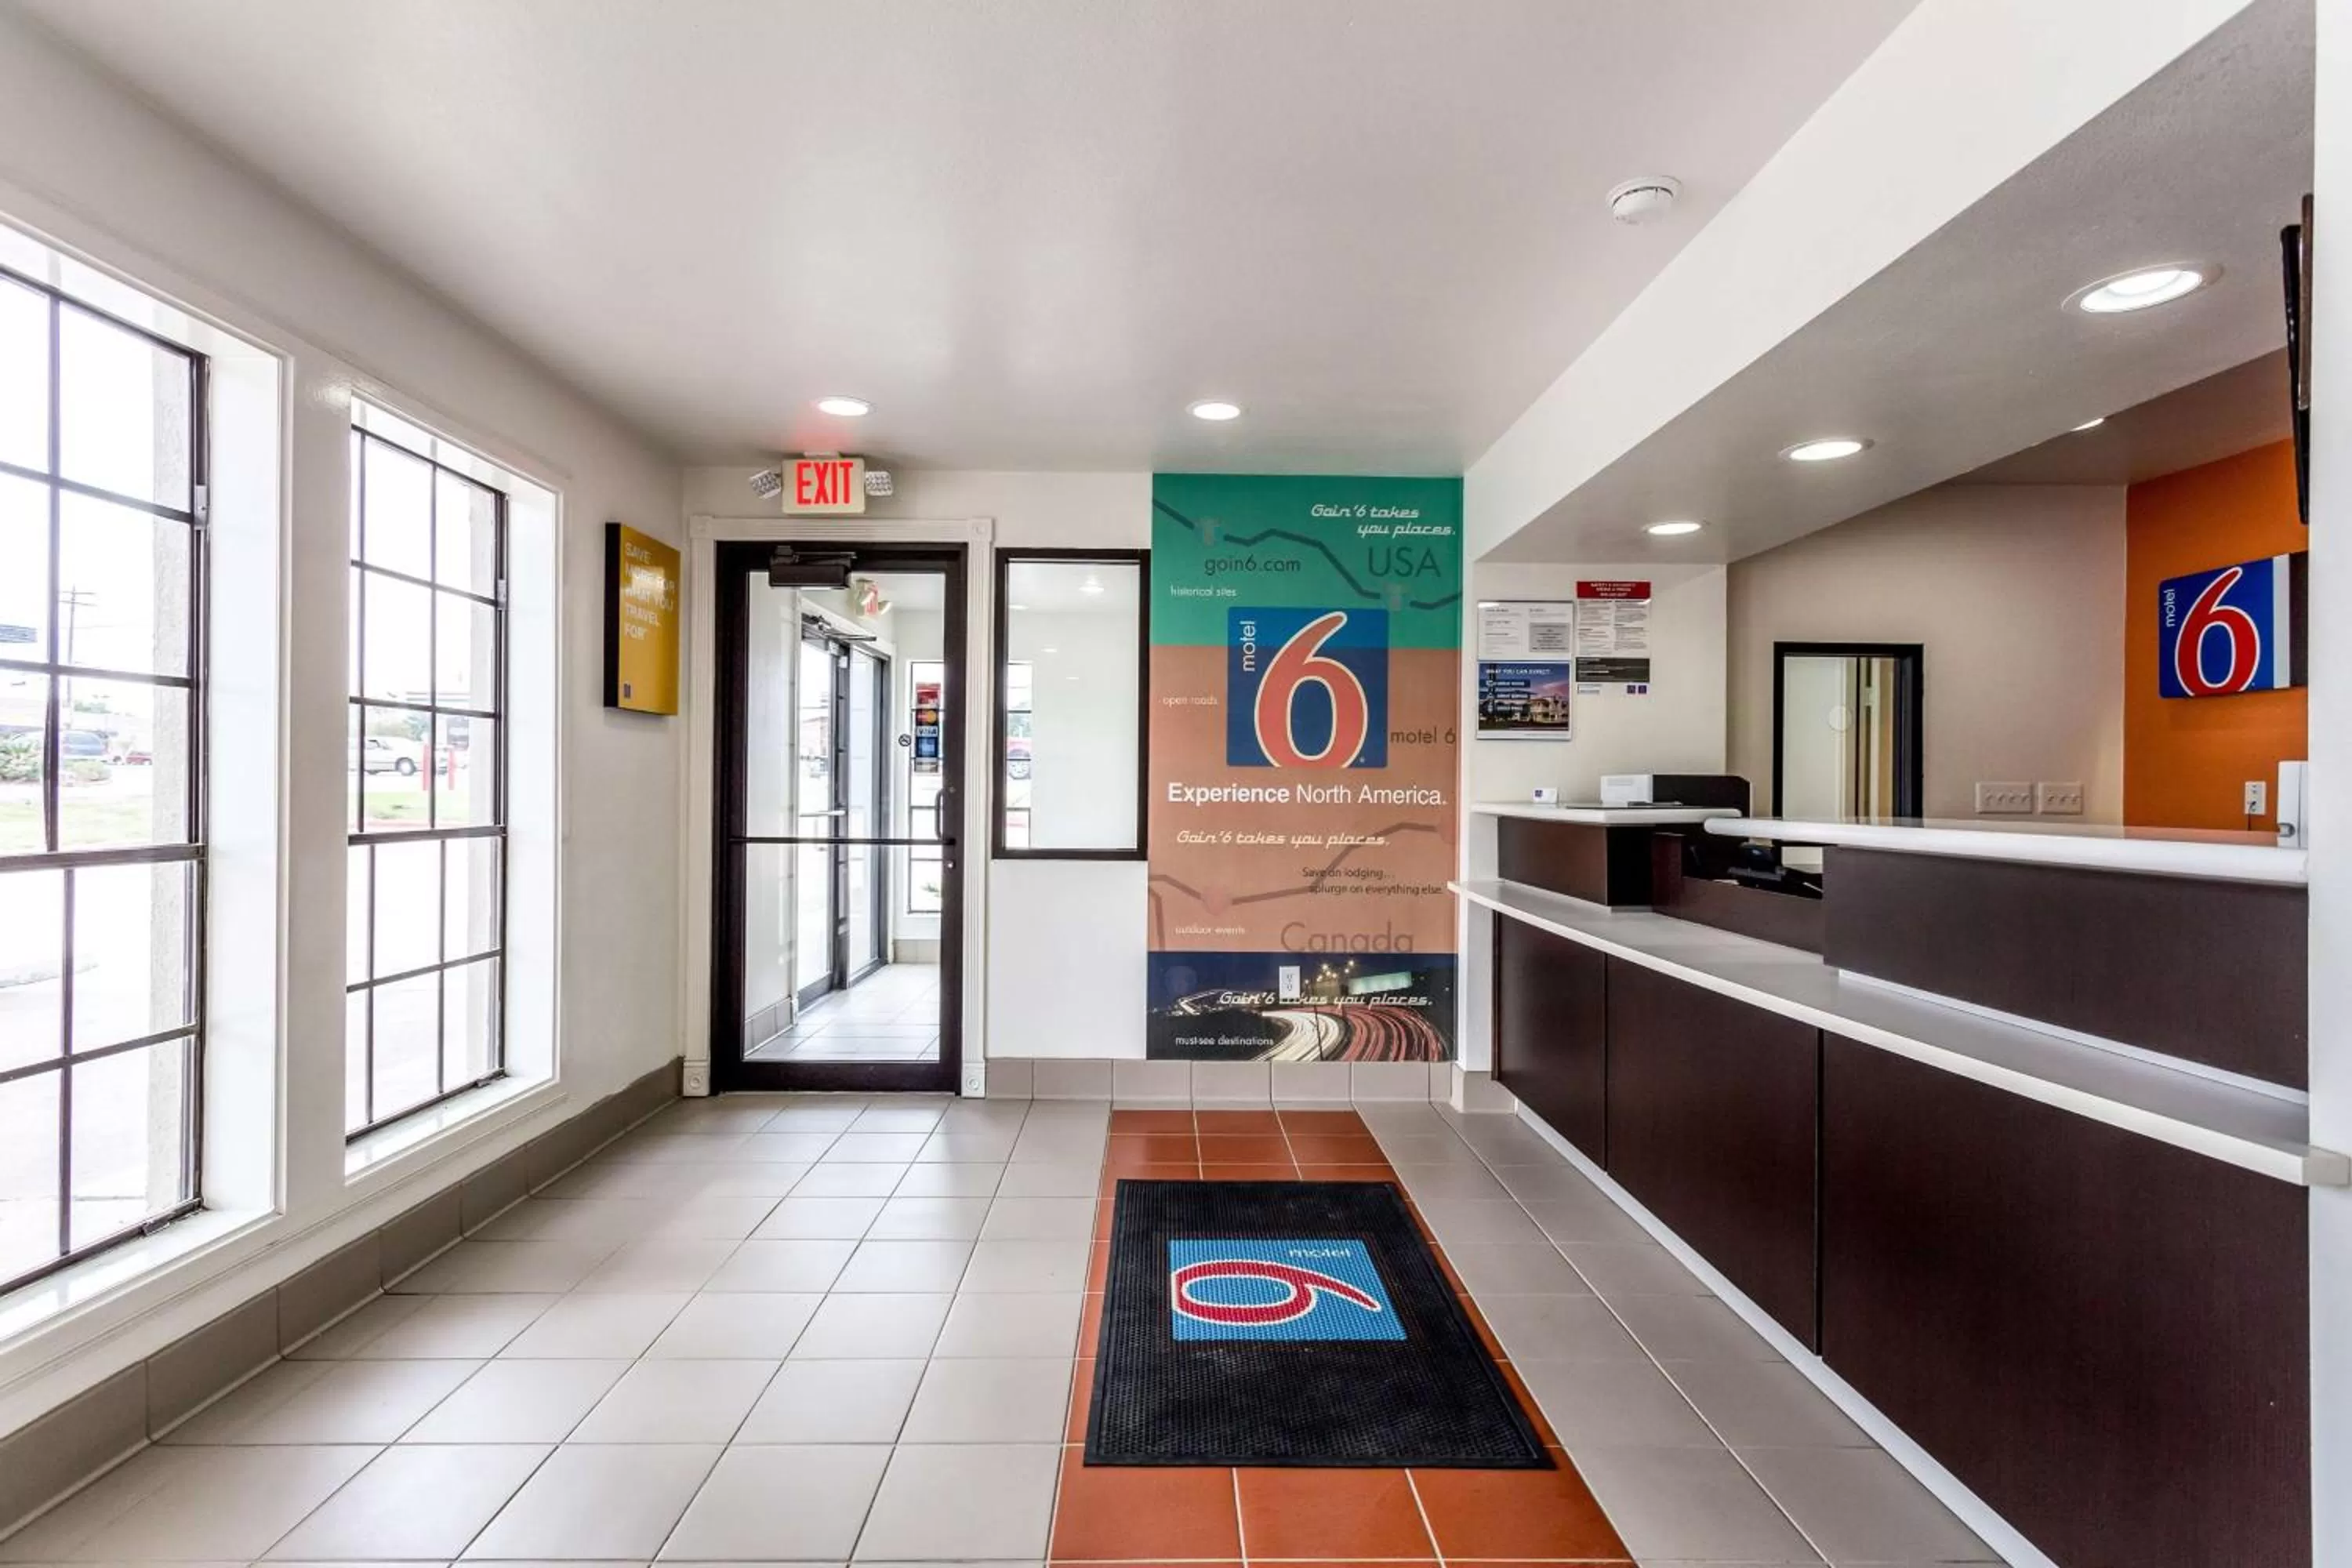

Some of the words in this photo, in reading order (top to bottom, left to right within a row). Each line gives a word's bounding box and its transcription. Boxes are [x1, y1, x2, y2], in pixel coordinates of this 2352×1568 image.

[797, 461, 853, 504] EXIT
[1370, 506, 1421, 518] takes
[1357, 524, 1389, 539] you
[1392, 522, 1456, 539] places.
[1204, 555, 1301, 575] goin6.com
[1368, 546, 1441, 578] USA
[1171, 584, 1213, 597] historical
[1216, 586, 1236, 597] sites
[2164, 589, 2175, 627] motel
[2175, 566, 2260, 697] 6
[1240, 620, 1256, 672] motel
[1254, 611, 1368, 768] 6
[1163, 695, 1188, 708] open
[1390, 726, 1436, 743] motel
[1445, 727, 1455, 744] 6
[1168, 782, 1289, 807] Experience
[1296, 784, 1351, 804] North
[1358, 784, 1447, 805] America.
[1236, 831, 1286, 844] takes
[1290, 833, 1323, 849] you
[1326, 833, 1390, 849] places.
[1349, 885, 1363, 894] on
[1366, 884, 1419, 896] everything
[1280, 920, 1414, 953] Canada
[1334, 996, 1365, 1010] you
[1369, 993, 1433, 1010] places.
[1218, 1035, 1274, 1046] destinations
[1290, 1247, 1351, 1258] motel
[1172, 1259, 1381, 1325] 6
